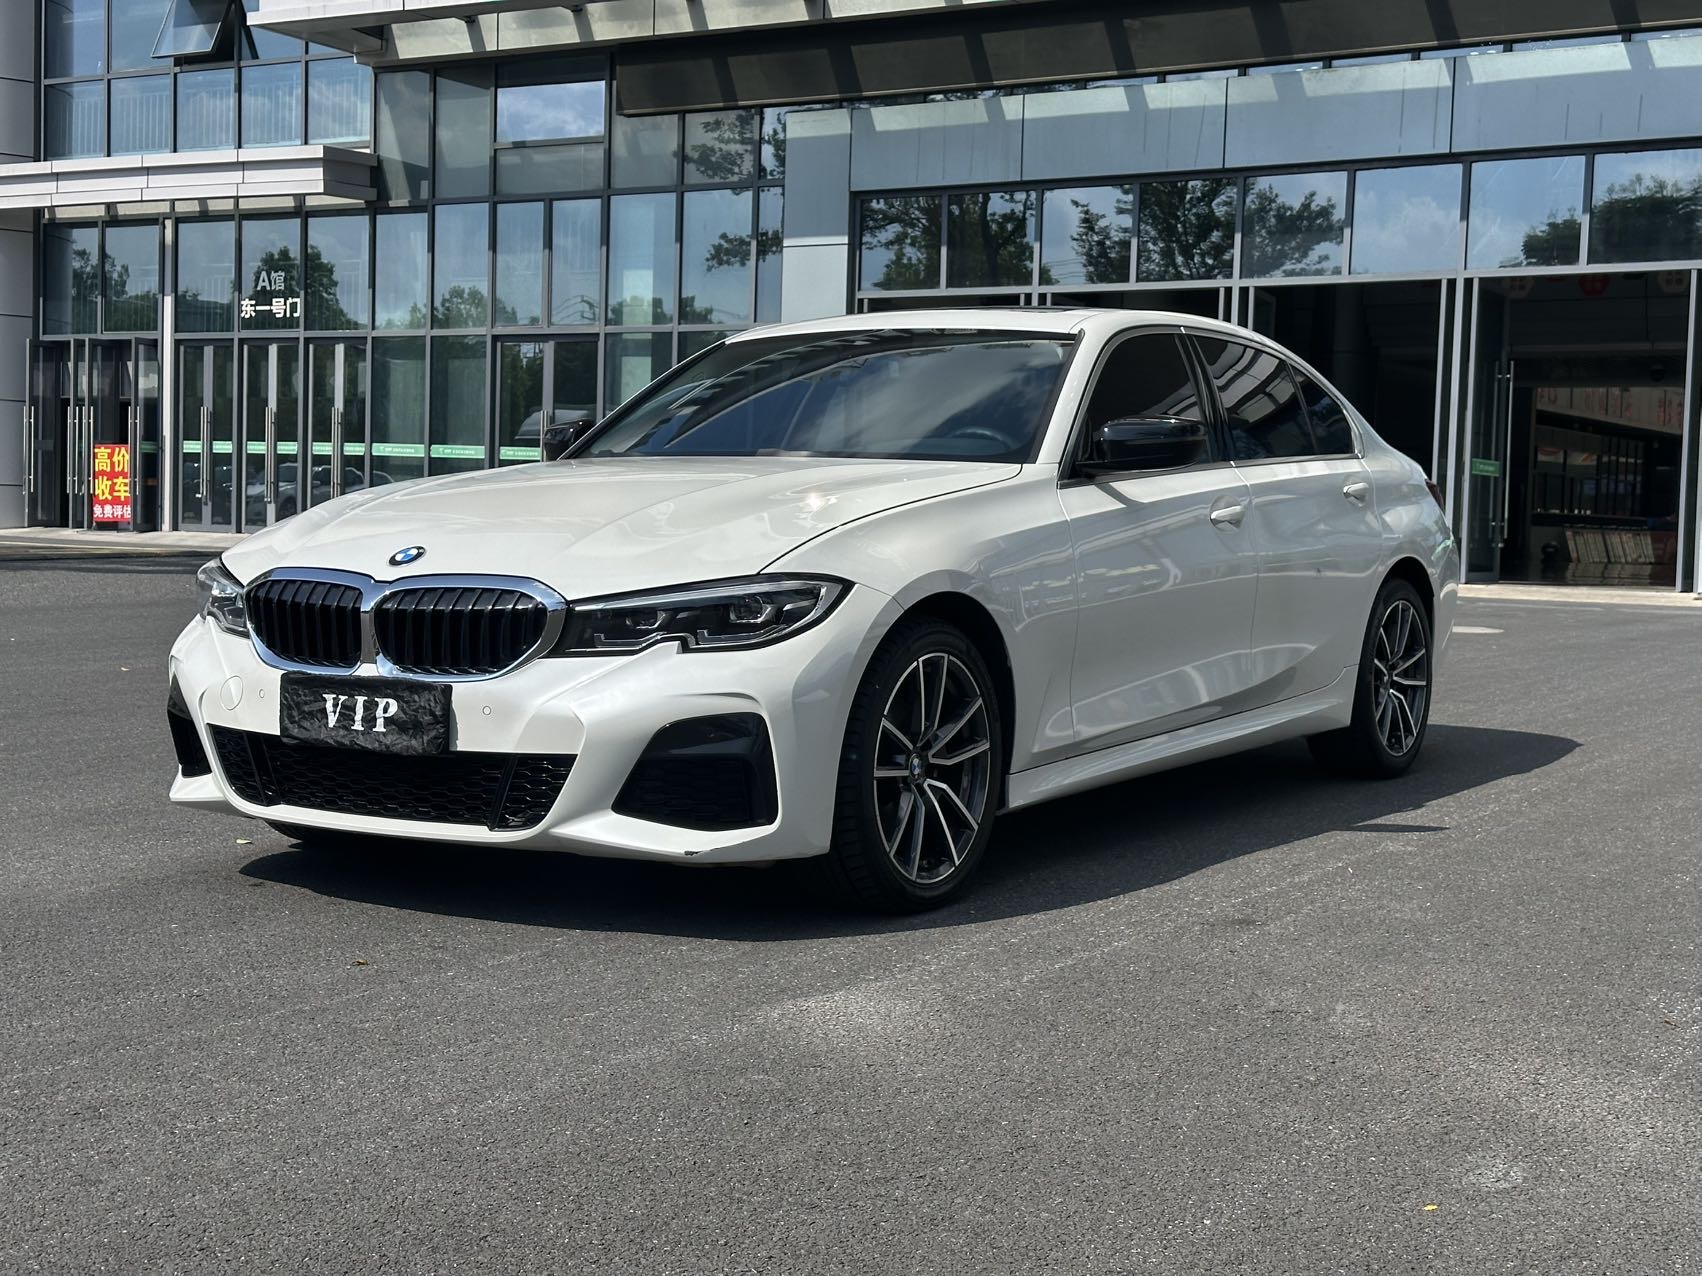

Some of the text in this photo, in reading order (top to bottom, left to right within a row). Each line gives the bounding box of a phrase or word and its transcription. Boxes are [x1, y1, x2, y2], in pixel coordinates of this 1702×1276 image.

[257, 270, 285, 290] A馆
[241, 297, 300, 318] 东一号门
[95, 447, 129, 472] 高价
[95, 476, 130, 501] 收车
[93, 504, 131, 518] 免费评估
[323, 693, 398, 732] VIP
